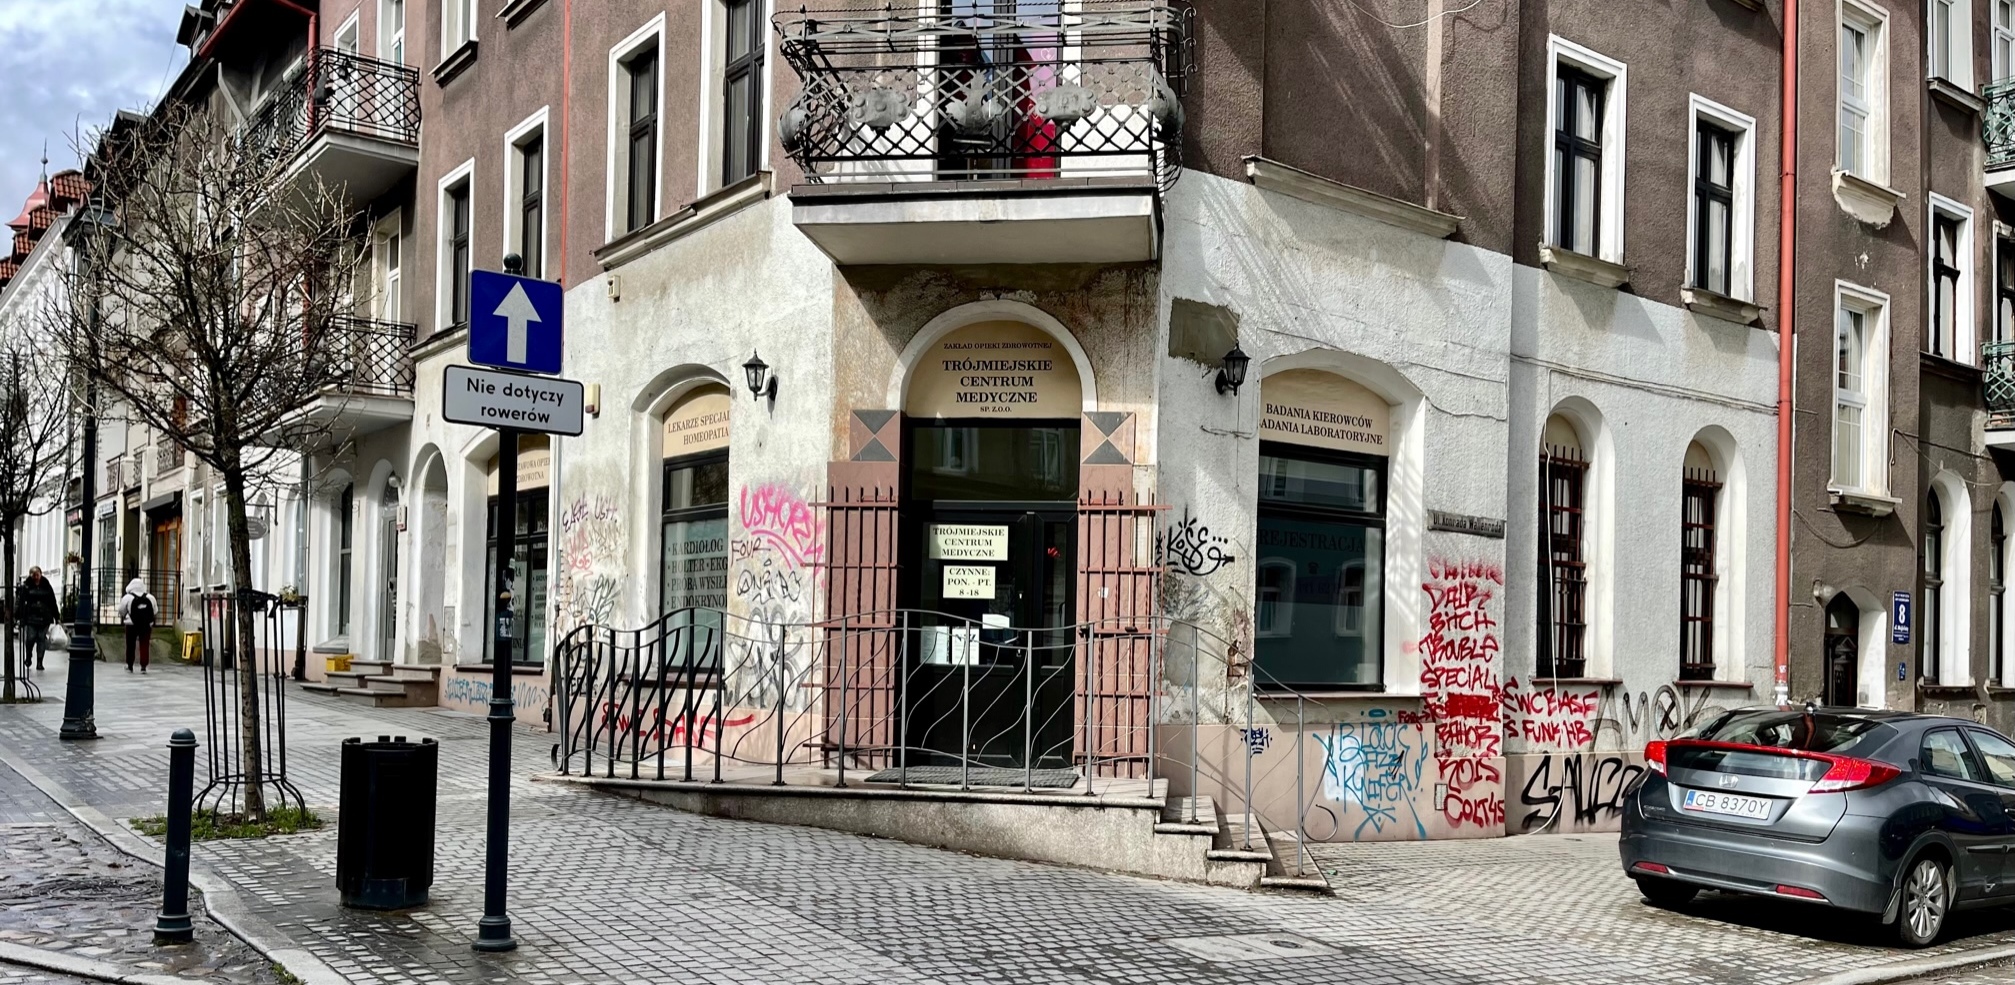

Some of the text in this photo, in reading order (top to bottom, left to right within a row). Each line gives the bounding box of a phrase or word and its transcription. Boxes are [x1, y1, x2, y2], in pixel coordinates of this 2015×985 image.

[943, 342, 973, 350] ZAKŁAD
[942, 357, 1053, 371] TRÓJMIEJSKIE
[960, 376, 1034, 387] CENTRUM
[466, 377, 564, 407] Nie dotyczy
[956, 391, 1038, 403] MEDYCZNE
[481, 405, 550, 424] rowerów
[1266, 402, 1373, 429] BADANIA KIEROWCÓW
[668, 416, 699, 434] LEKARZE
[1260, 418, 1383, 445] ADANIA LABORATORYJNE
[683, 426, 729, 445] HOMEOPATIA
[933, 526, 1005, 536] TRÓJMIEJSKIE
[672, 538, 724, 556] KARDIOLOG
[944, 538, 992, 547] CENTRUM
[1258, 529, 1365, 553] REJESTRACJA
[941, 548, 995, 557] MEDYCZNE
[672, 558, 705, 574] HOLTER
[949, 567, 991, 576] CZYNNE:
[947, 578, 970, 587] PON.
[977, 578, 992, 587] PT.
[1898, 603, 1906, 624] 8
[1695, 793, 1716, 808] CB
[1720, 796, 1768, 815] 8370Y
